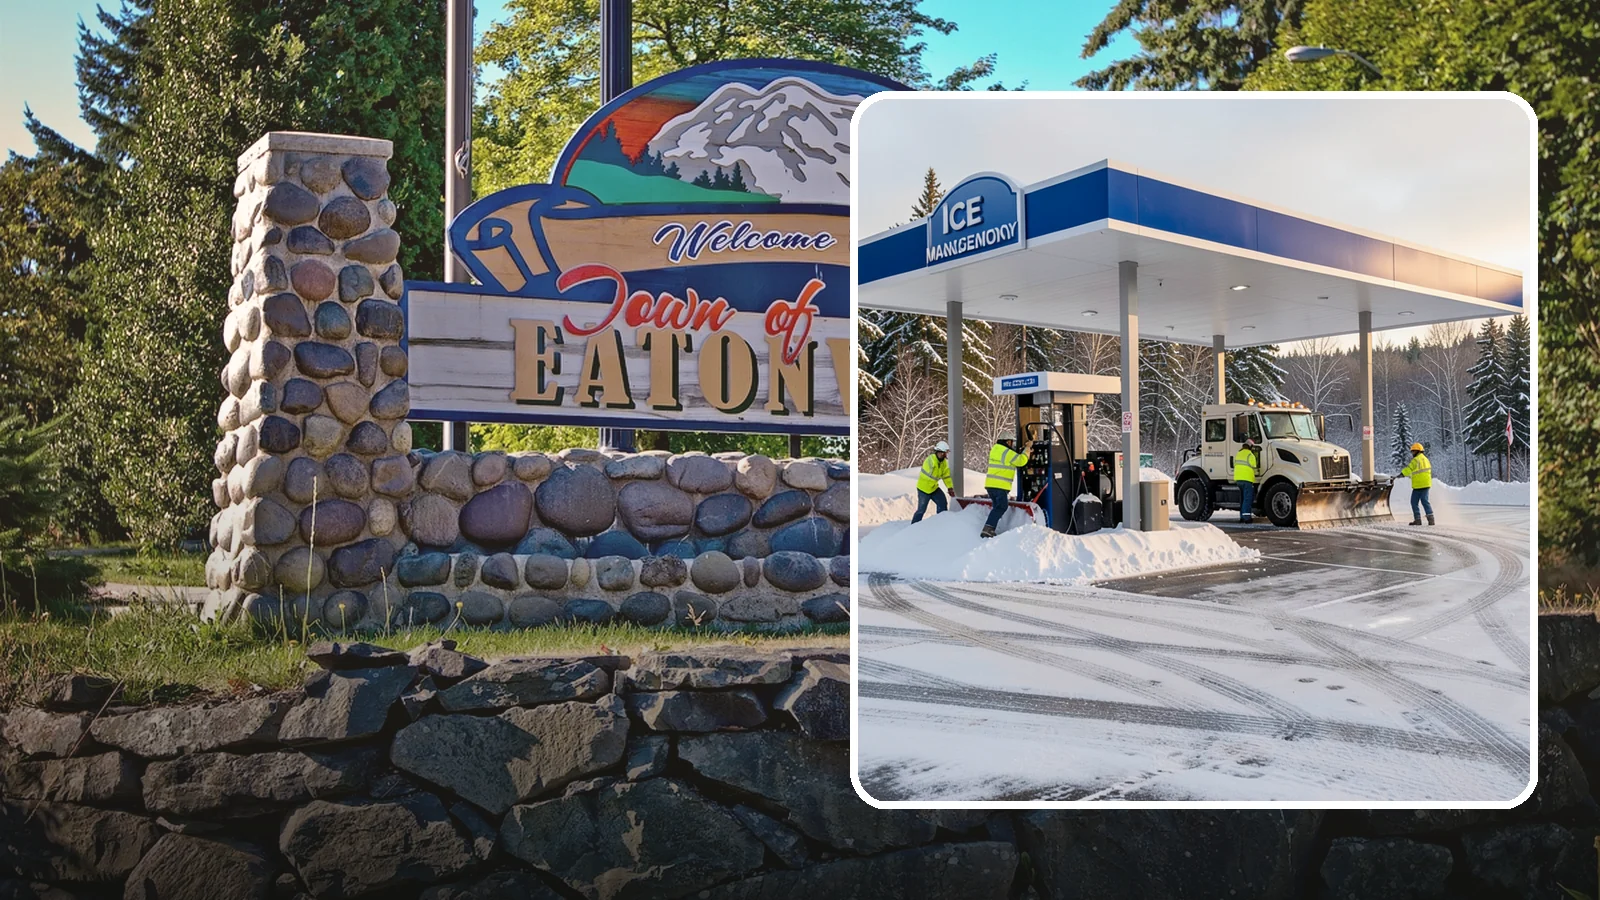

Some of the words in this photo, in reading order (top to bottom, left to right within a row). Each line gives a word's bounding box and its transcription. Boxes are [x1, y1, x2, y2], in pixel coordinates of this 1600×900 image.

[942, 196, 982, 234] ICE
[654, 220, 836, 262] Welcome
[557, 263, 735, 335] Town
[765, 279, 826, 366] of
